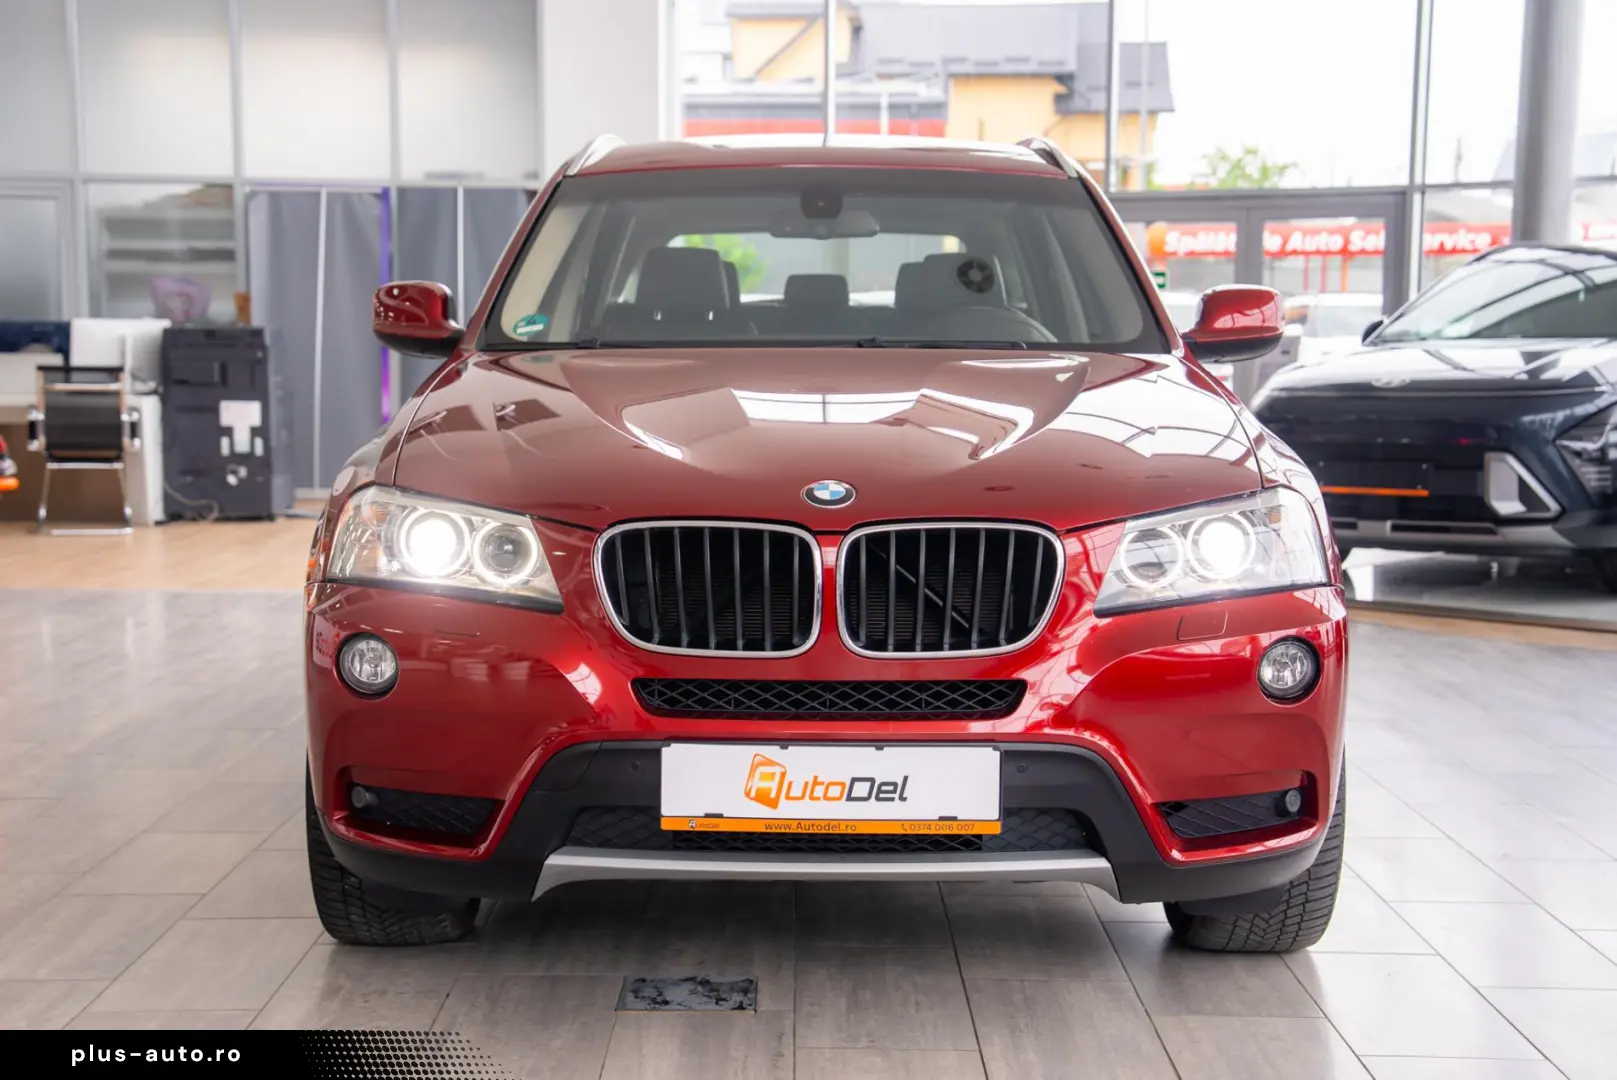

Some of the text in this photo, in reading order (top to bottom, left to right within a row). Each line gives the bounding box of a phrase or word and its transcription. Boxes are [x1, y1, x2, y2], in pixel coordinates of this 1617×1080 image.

[1286, 230, 1344, 252] Auto
[1347, 229, 1386, 252] Sel
[1421, 228, 1492, 252] ervice
[746, 758, 909, 804] AutoDel
[764, 821, 857, 832] www.Autodel.ro
[909, 823, 932, 832] 0374
